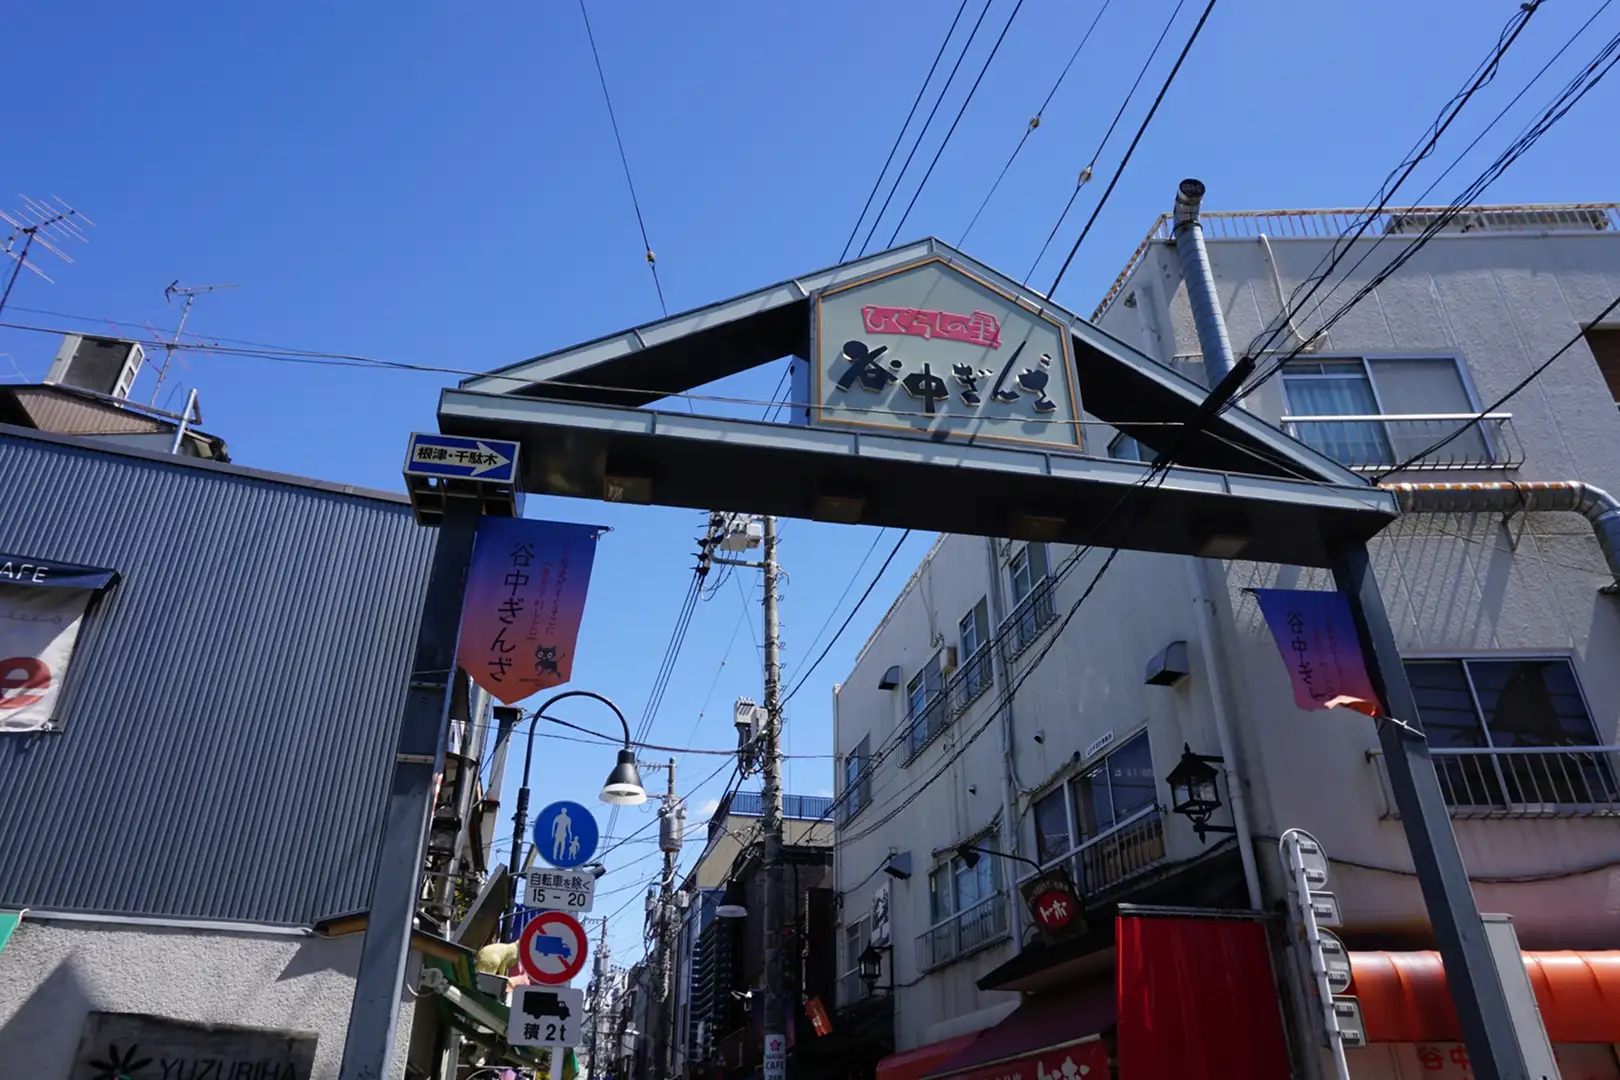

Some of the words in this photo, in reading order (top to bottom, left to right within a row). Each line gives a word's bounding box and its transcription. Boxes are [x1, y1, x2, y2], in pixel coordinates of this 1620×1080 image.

[862, 305, 1001, 349] ひぐらしの里
[836, 340, 1058, 417] 谷中ぎんざ
[417, 446, 499, 466] 根津・千駄木
[488, 541, 535, 682] 谷中ぎんざ
[530, 872, 592, 892] 自転車を除く
